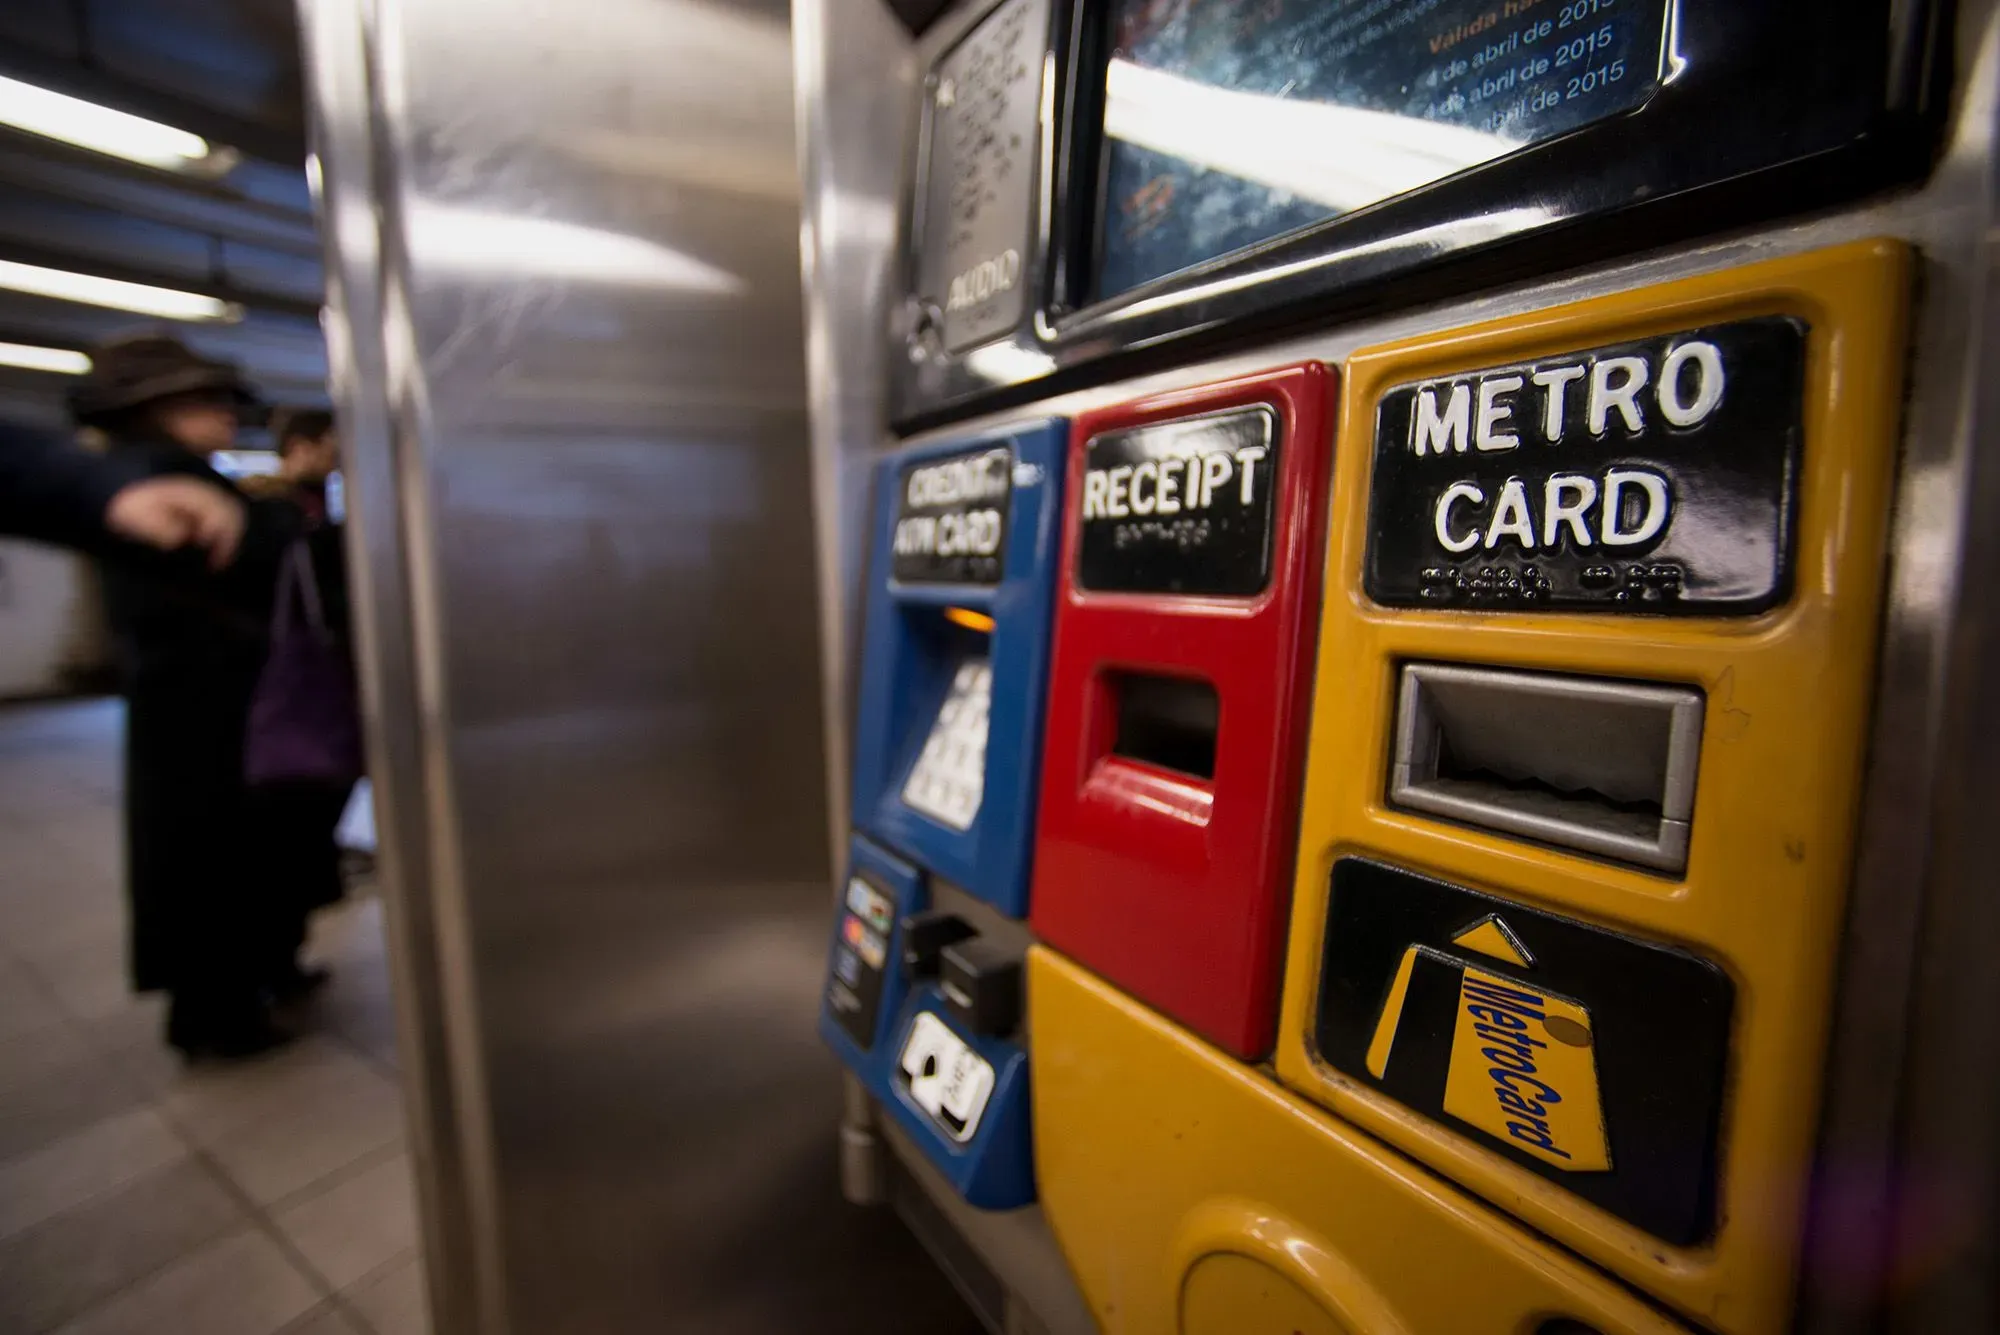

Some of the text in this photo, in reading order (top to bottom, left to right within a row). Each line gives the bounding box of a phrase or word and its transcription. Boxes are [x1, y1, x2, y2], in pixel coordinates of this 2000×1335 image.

[1442, 60, 1468, 82] de
[1471, 31, 1519, 69] abril
[1523, 19, 1552, 45] de
[1469, 67, 1516, 104] abril
[1520, 57, 1549, 81] de
[1555, 24, 1613, 67] 2015
[1531, 88, 1560, 113] de
[1566, 59, 1625, 100] 2015
[1412, 341, 1727, 457] METRO
[1082, 446, 1268, 521] RECEIPT
[1434, 468, 1670, 553] CARD
[936, 509, 1001, 557] CARD
[1462, 975, 1573, 1161] MetroCard
